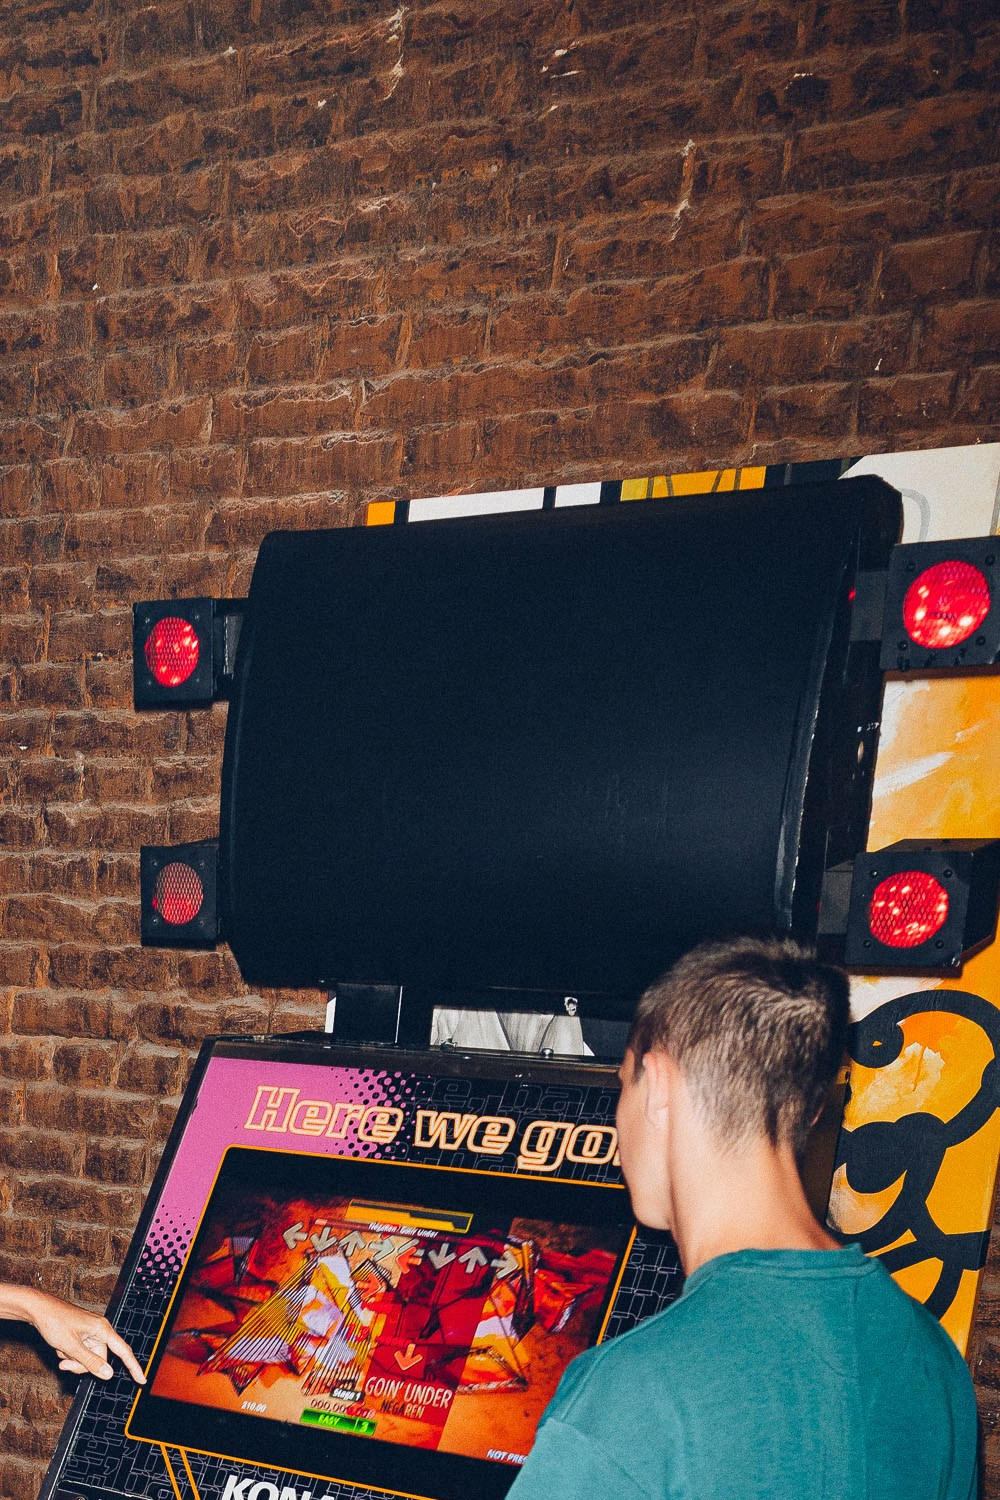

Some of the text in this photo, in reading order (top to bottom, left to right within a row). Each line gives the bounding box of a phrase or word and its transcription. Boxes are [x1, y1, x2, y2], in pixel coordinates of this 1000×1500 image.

[243, 1085, 404, 1144] Here
[414, 1109, 517, 1155] we
[517, 1119, 622, 1172] go
[364, 1375, 453, 1409] GOIN' UNDER
[379, 1399, 425, 1419] NEGAREN
[317, 1413, 369, 1433] EASY 3
[486, 1448, 508, 1461] NOT
